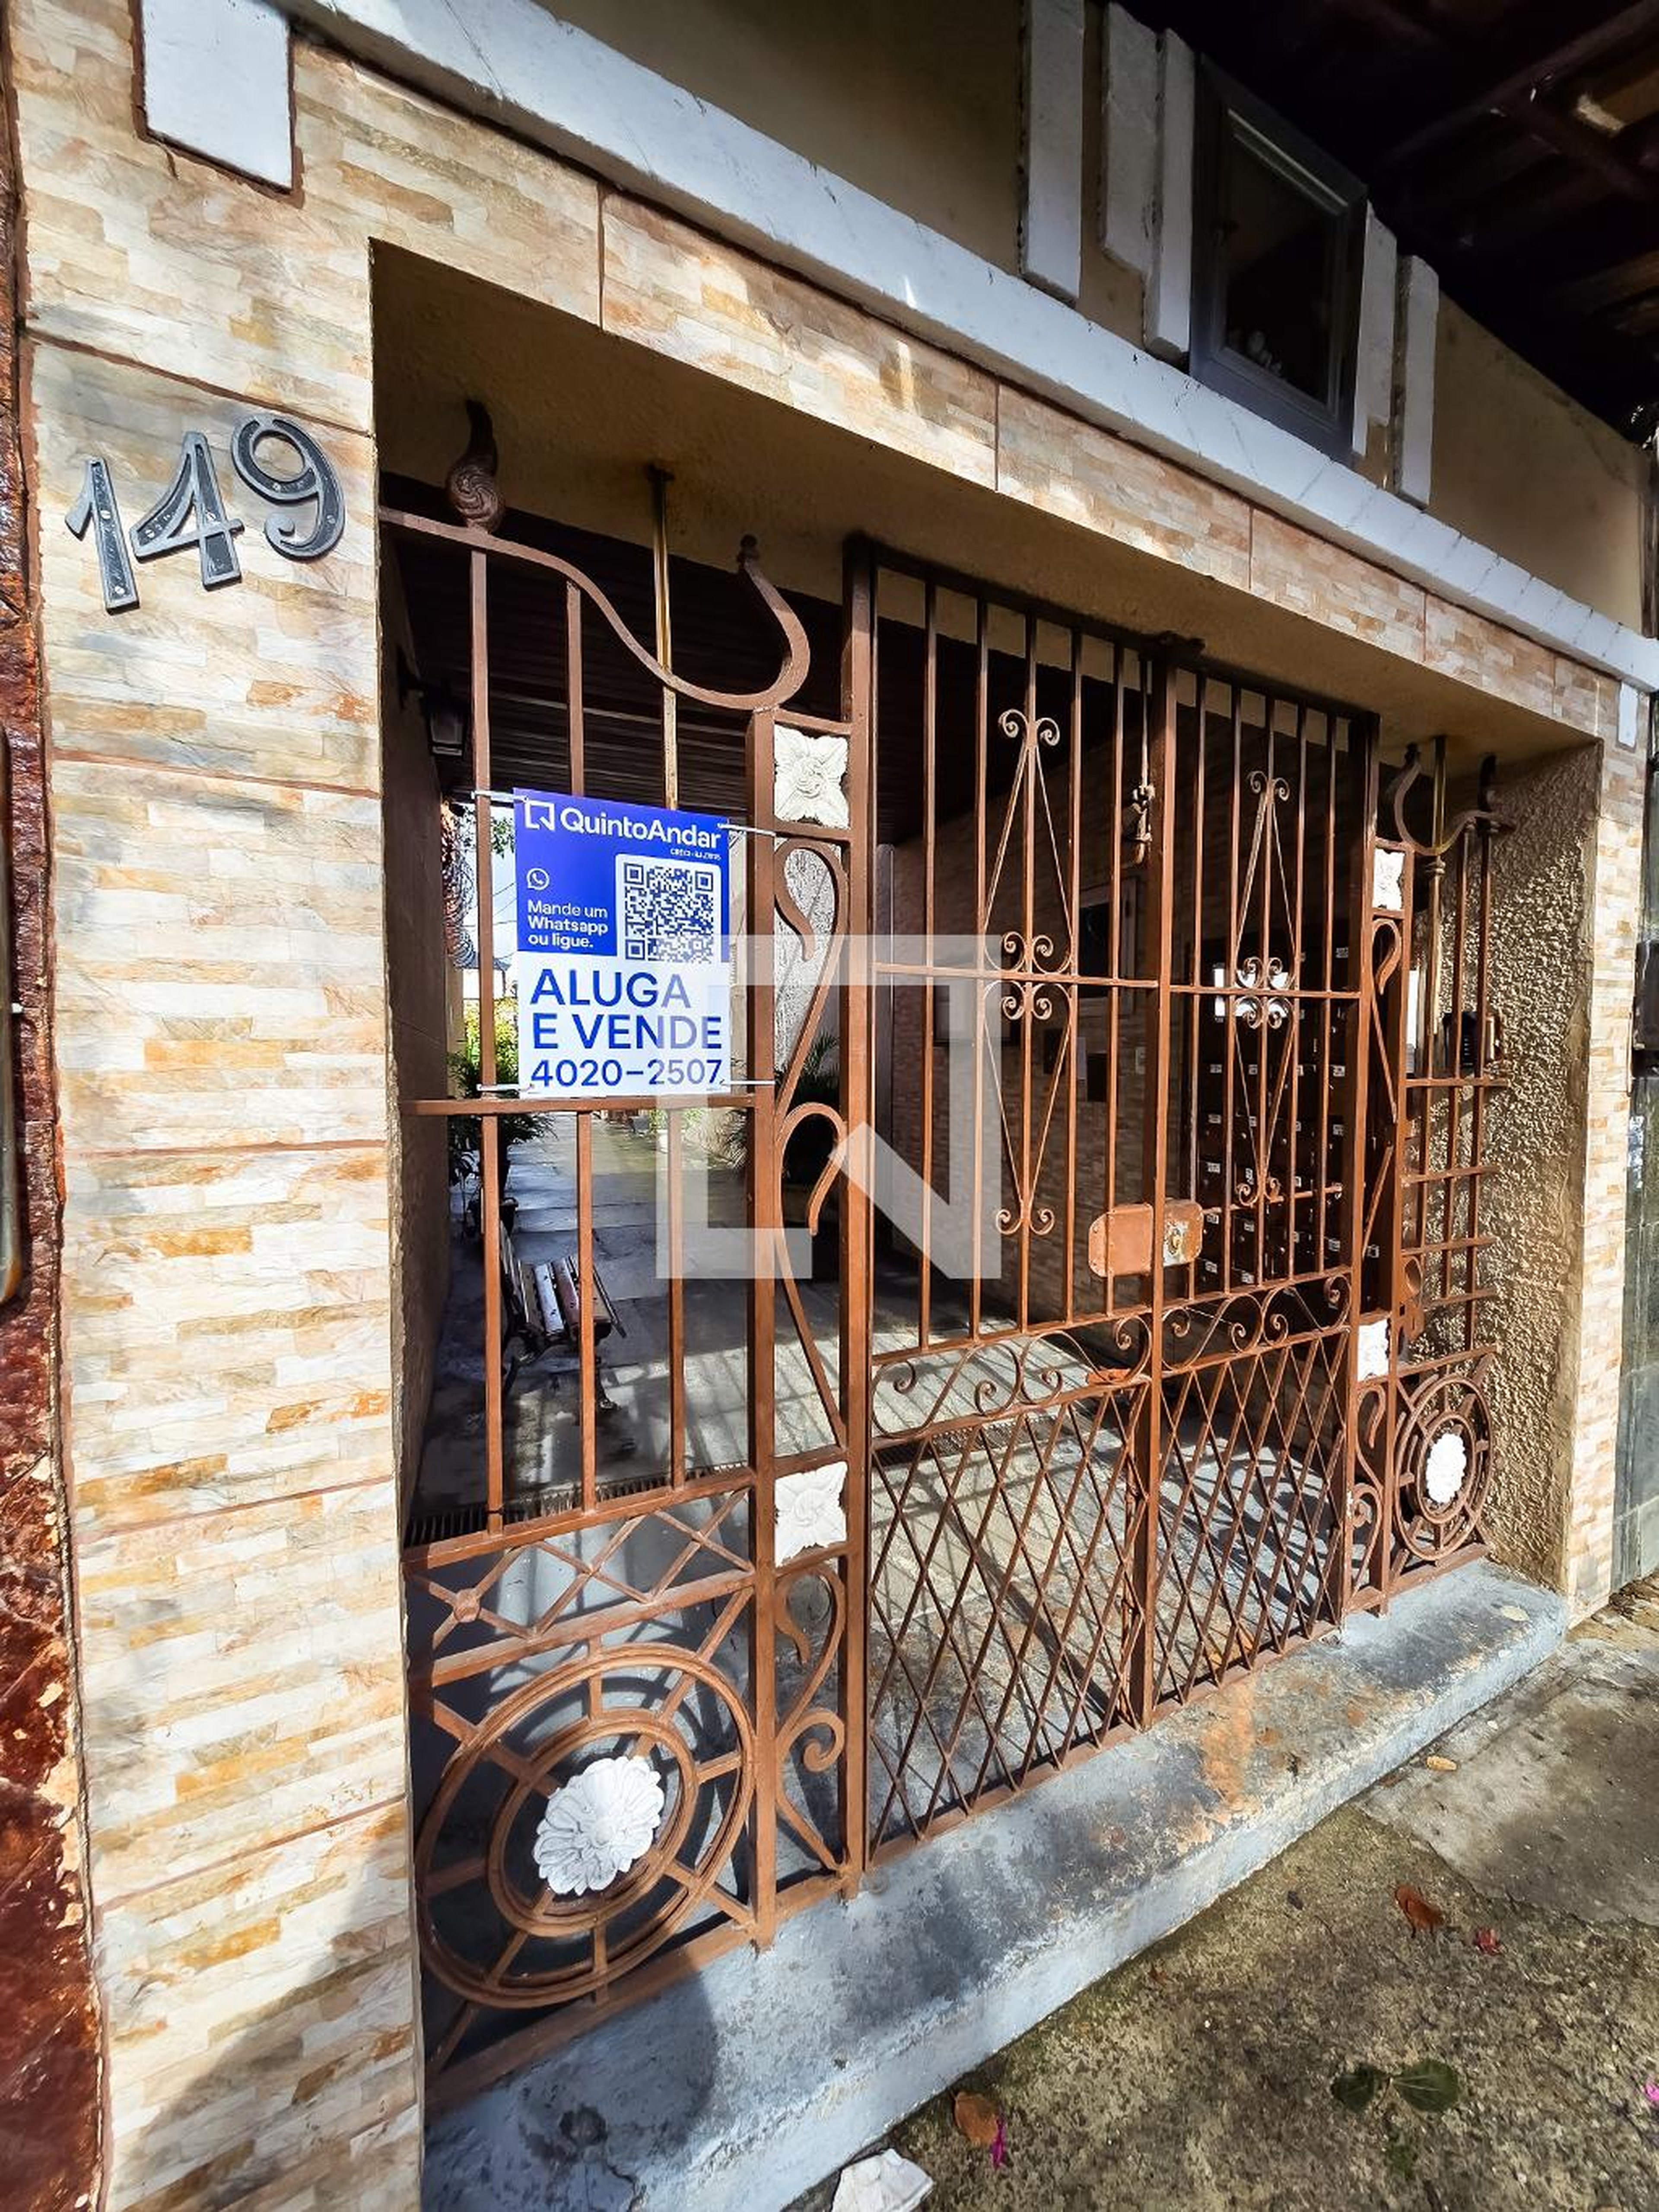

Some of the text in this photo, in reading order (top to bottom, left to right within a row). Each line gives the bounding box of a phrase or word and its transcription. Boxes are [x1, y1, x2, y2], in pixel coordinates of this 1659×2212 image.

[65, 413, 346, 615] 149
[560, 808, 721, 849] QuintoAndar
[528, 899, 608, 918] Mande um
[528, 916, 608, 936] Whatsapp
[528, 933, 594, 950] ou ligue.
[530, 968, 691, 1009] ALUGA
[533, 1012, 722, 1049] E VENDE
[531, 1059, 722, 1087] 4020-2507
